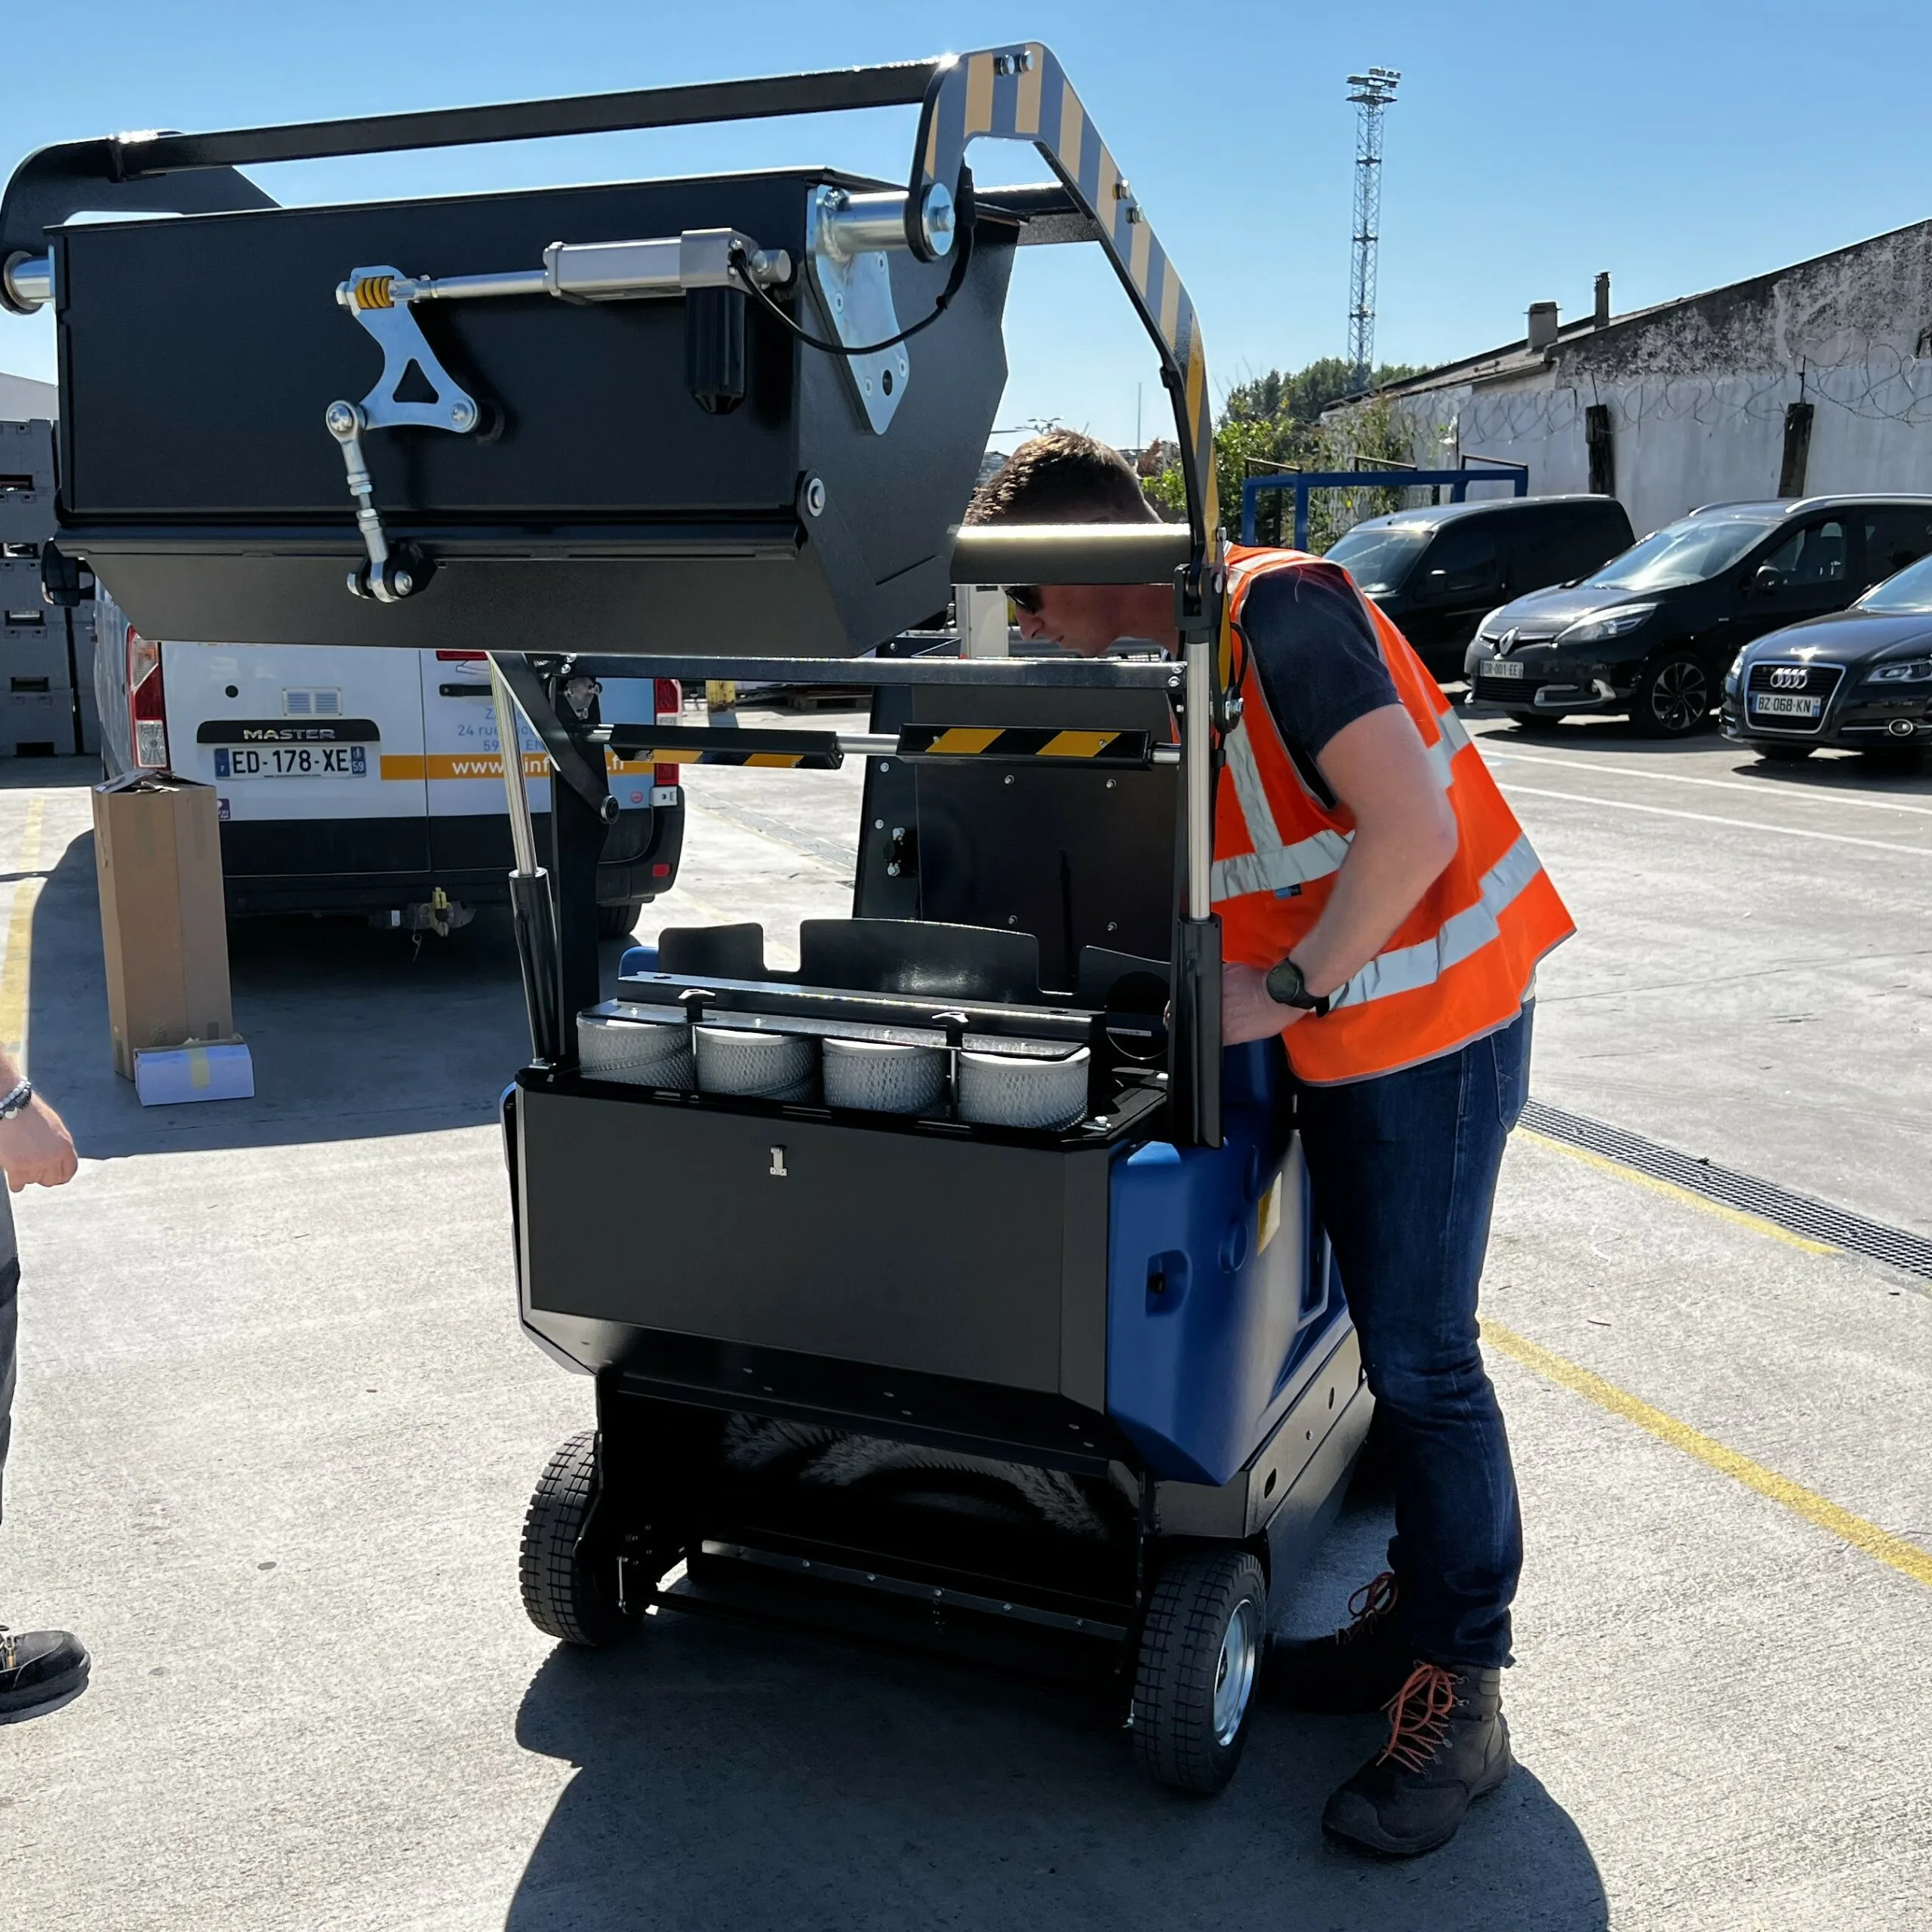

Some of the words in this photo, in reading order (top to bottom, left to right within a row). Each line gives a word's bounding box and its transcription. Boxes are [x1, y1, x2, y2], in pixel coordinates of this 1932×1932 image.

[243, 728, 336, 740] MASTER
[457, 724, 474, 737] 24
[232, 749, 350, 774] ED-178-XE
[352, 760, 365, 773] 59
